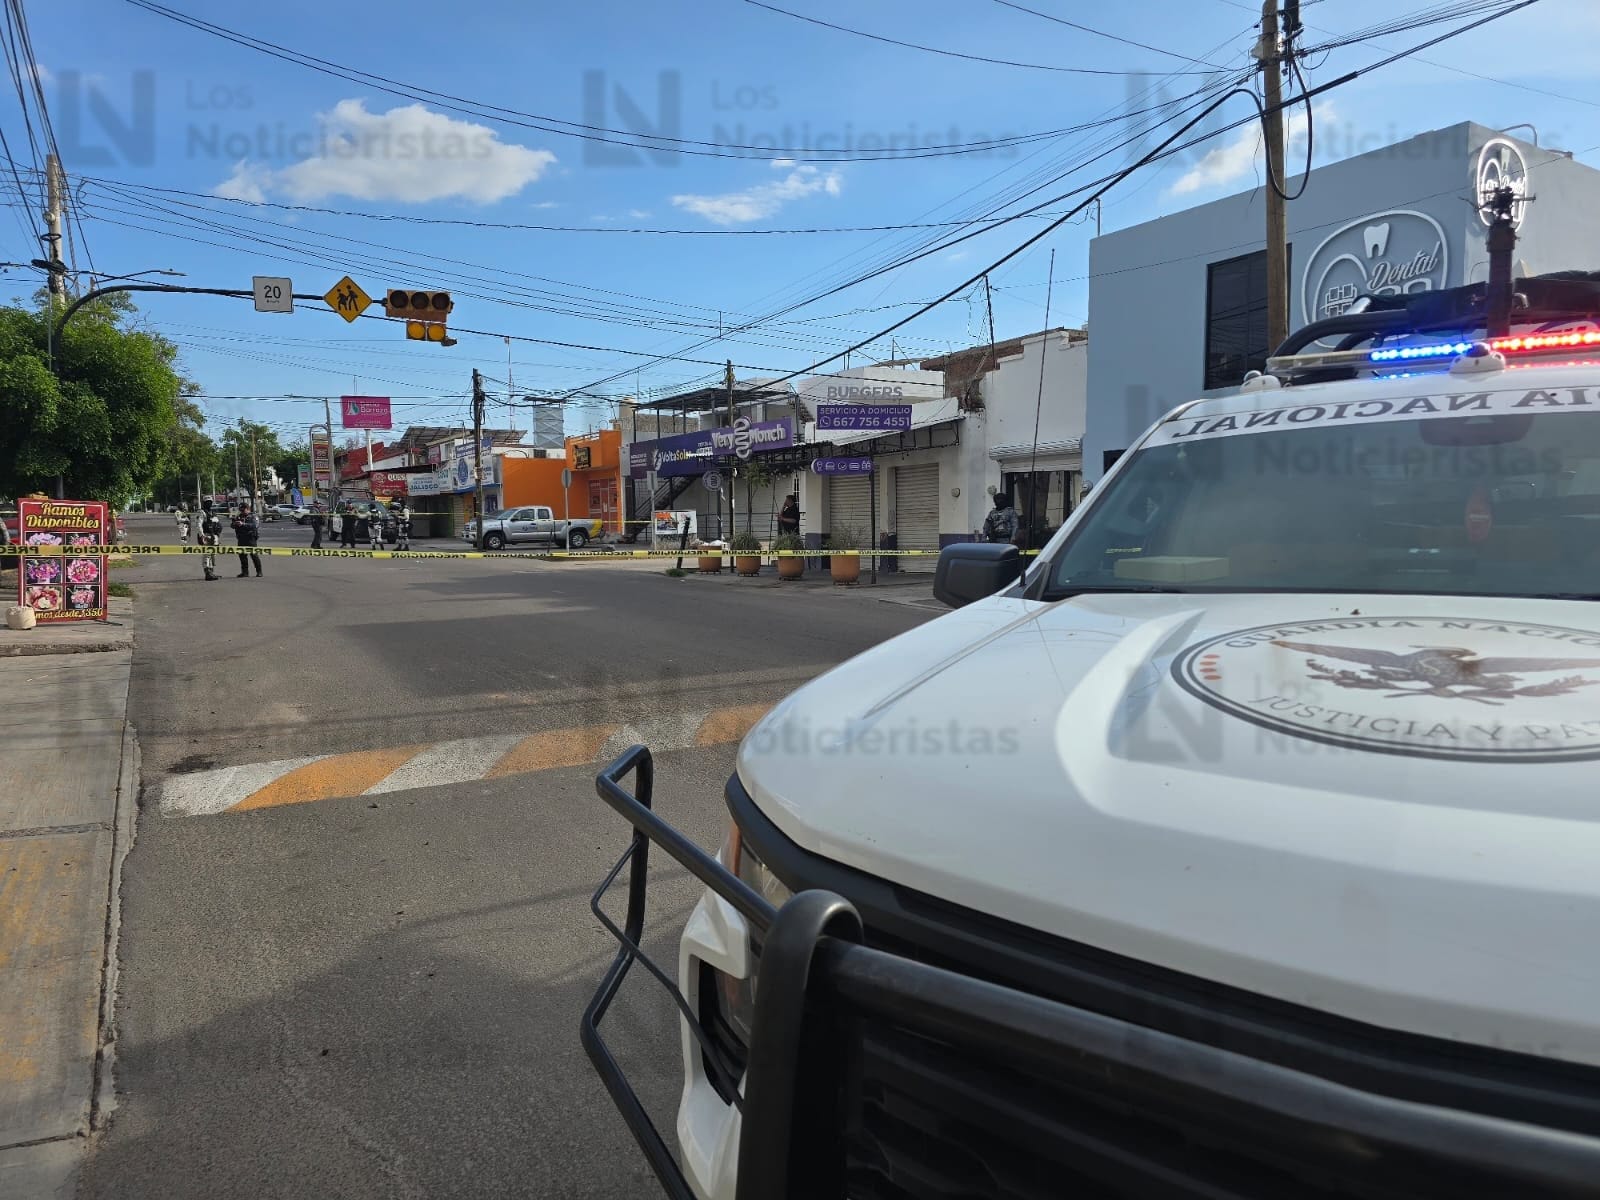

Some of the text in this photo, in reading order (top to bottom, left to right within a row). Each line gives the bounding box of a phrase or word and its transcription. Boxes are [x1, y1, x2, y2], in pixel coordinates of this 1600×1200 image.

[1367, 241, 1441, 291] Dental
[263, 285, 282, 299] 20
[827, 386, 903, 399] BURGERS
[820, 407, 911, 415] SERVICIO A DOMICILIO
[833, 417, 911, 427] 667 756 4551
[711, 432, 735, 450] Very
[41, 502, 85, 516] Ramos
[26, 515, 100, 529] Disponibles
[1225, 621, 1600, 649] GUARDIA NACIO
[1247, 696, 1460, 740] JUSTICIA
[1468, 724, 1504, 742] Y
